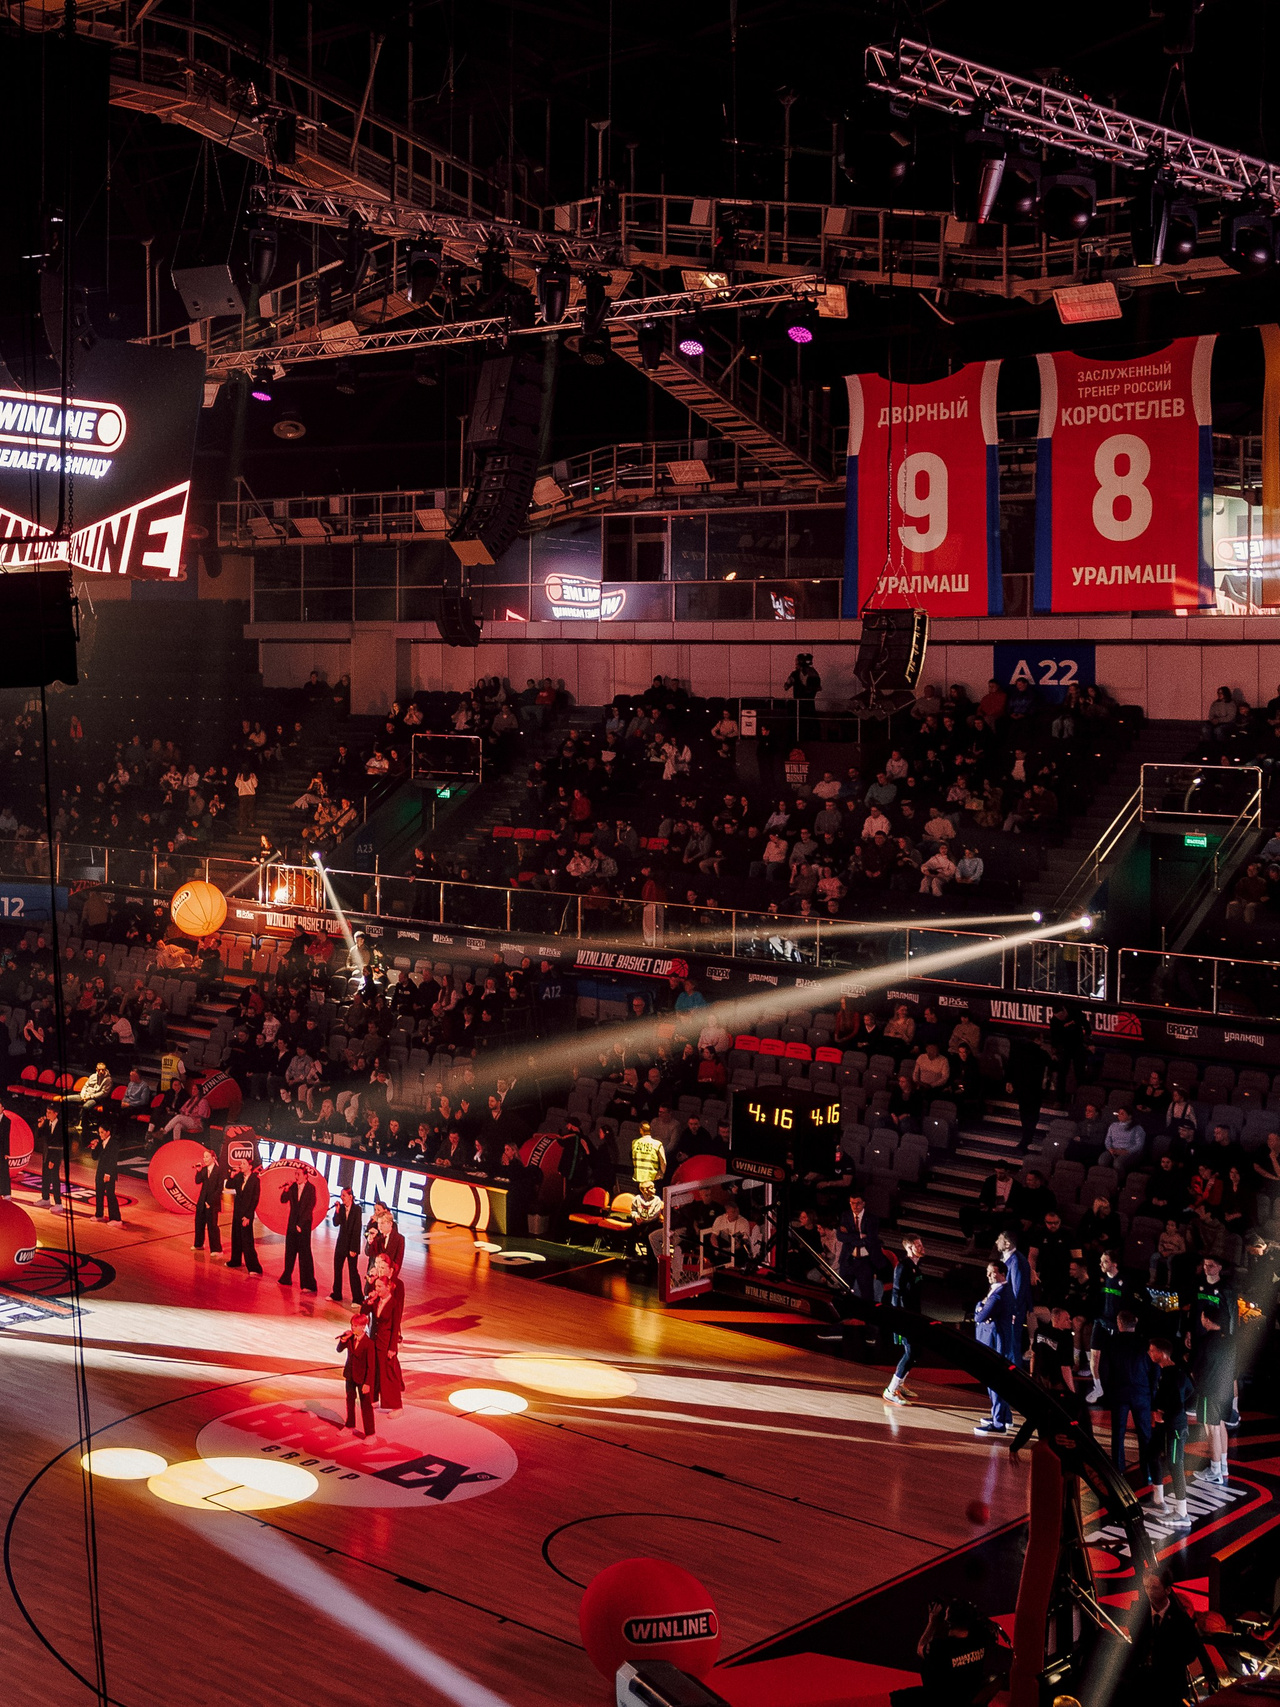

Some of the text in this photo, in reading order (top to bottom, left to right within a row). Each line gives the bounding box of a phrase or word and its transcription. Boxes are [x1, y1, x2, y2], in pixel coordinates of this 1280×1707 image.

[1077, 360, 1172, 383] ЗАСЛУЖЕННЫЙ
[1077, 380, 1172, 399] ТРЕНЕР РОССИИ
[877, 395, 969, 428] ДВОРНЫЙ
[1061, 398, 1186, 427] КОРОСТЕЛЕВ
[46, 453, 113, 480] РАЗНИЦУ
[1092, 433, 1153, 541] 8
[897, 452, 948, 553] 9
[876, 573, 970, 595] УРАЛМАШ
[1072, 563, 1177, 588] УРАЛМАШ
[1009, 658, 1079, 686] A22
[266, 912, 298, 931] WINLINE
[325, 920, 341, 936] CUP
[577, 950, 673, 976] WINLINE BASKET CUP
[542, 984, 561, 1000] A12
[990, 1000, 1036, 1022] WINLINE
[1094, 1013, 1120, 1032] CUP
[1224, 1031, 1265, 1047] УРАЛМАШ
[748, 1102, 793, 1130] 4:16
[811, 1103, 840, 1127] 4:16
[8, 1154, 32, 1168] INLINE
[233, 1149, 252, 1159] WIN
[530, 1137, 551, 1167] INLINE
[735, 1160, 774, 1177] WINLINE
[260, 1444, 362, 1481] GROUP
[631, 1616, 708, 1640] WINLINE
